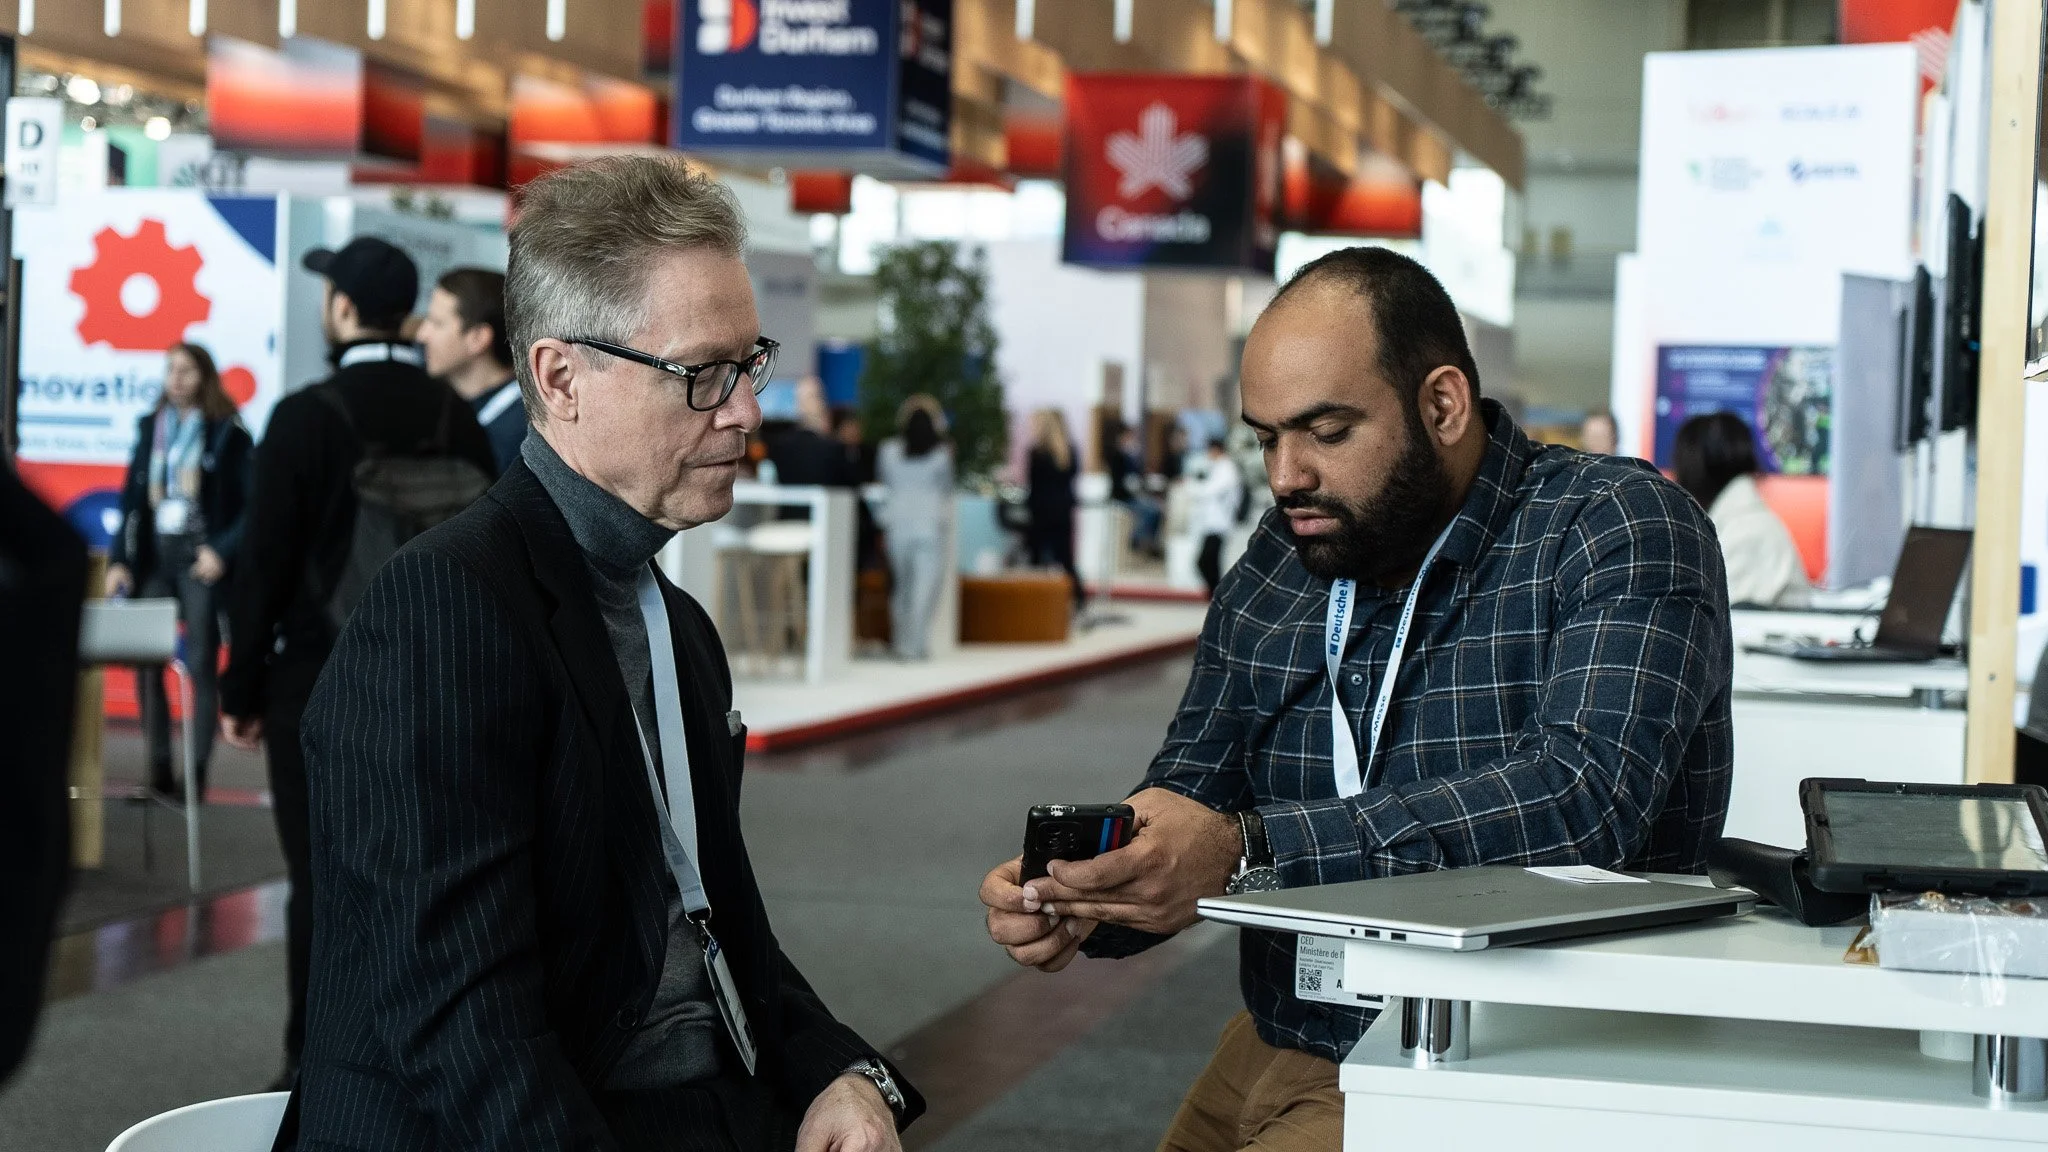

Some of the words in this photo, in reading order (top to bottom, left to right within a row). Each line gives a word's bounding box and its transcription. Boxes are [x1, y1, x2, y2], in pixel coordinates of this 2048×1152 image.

[759, 25, 878, 55] Durham
[20, 121, 42, 149] D
[1331, 589, 1349, 643] Deutsche
[1300, 936, 1314, 945] CEO
[1300, 946, 1329, 958] Ministère
[1330, 950, 1339, 959] de
